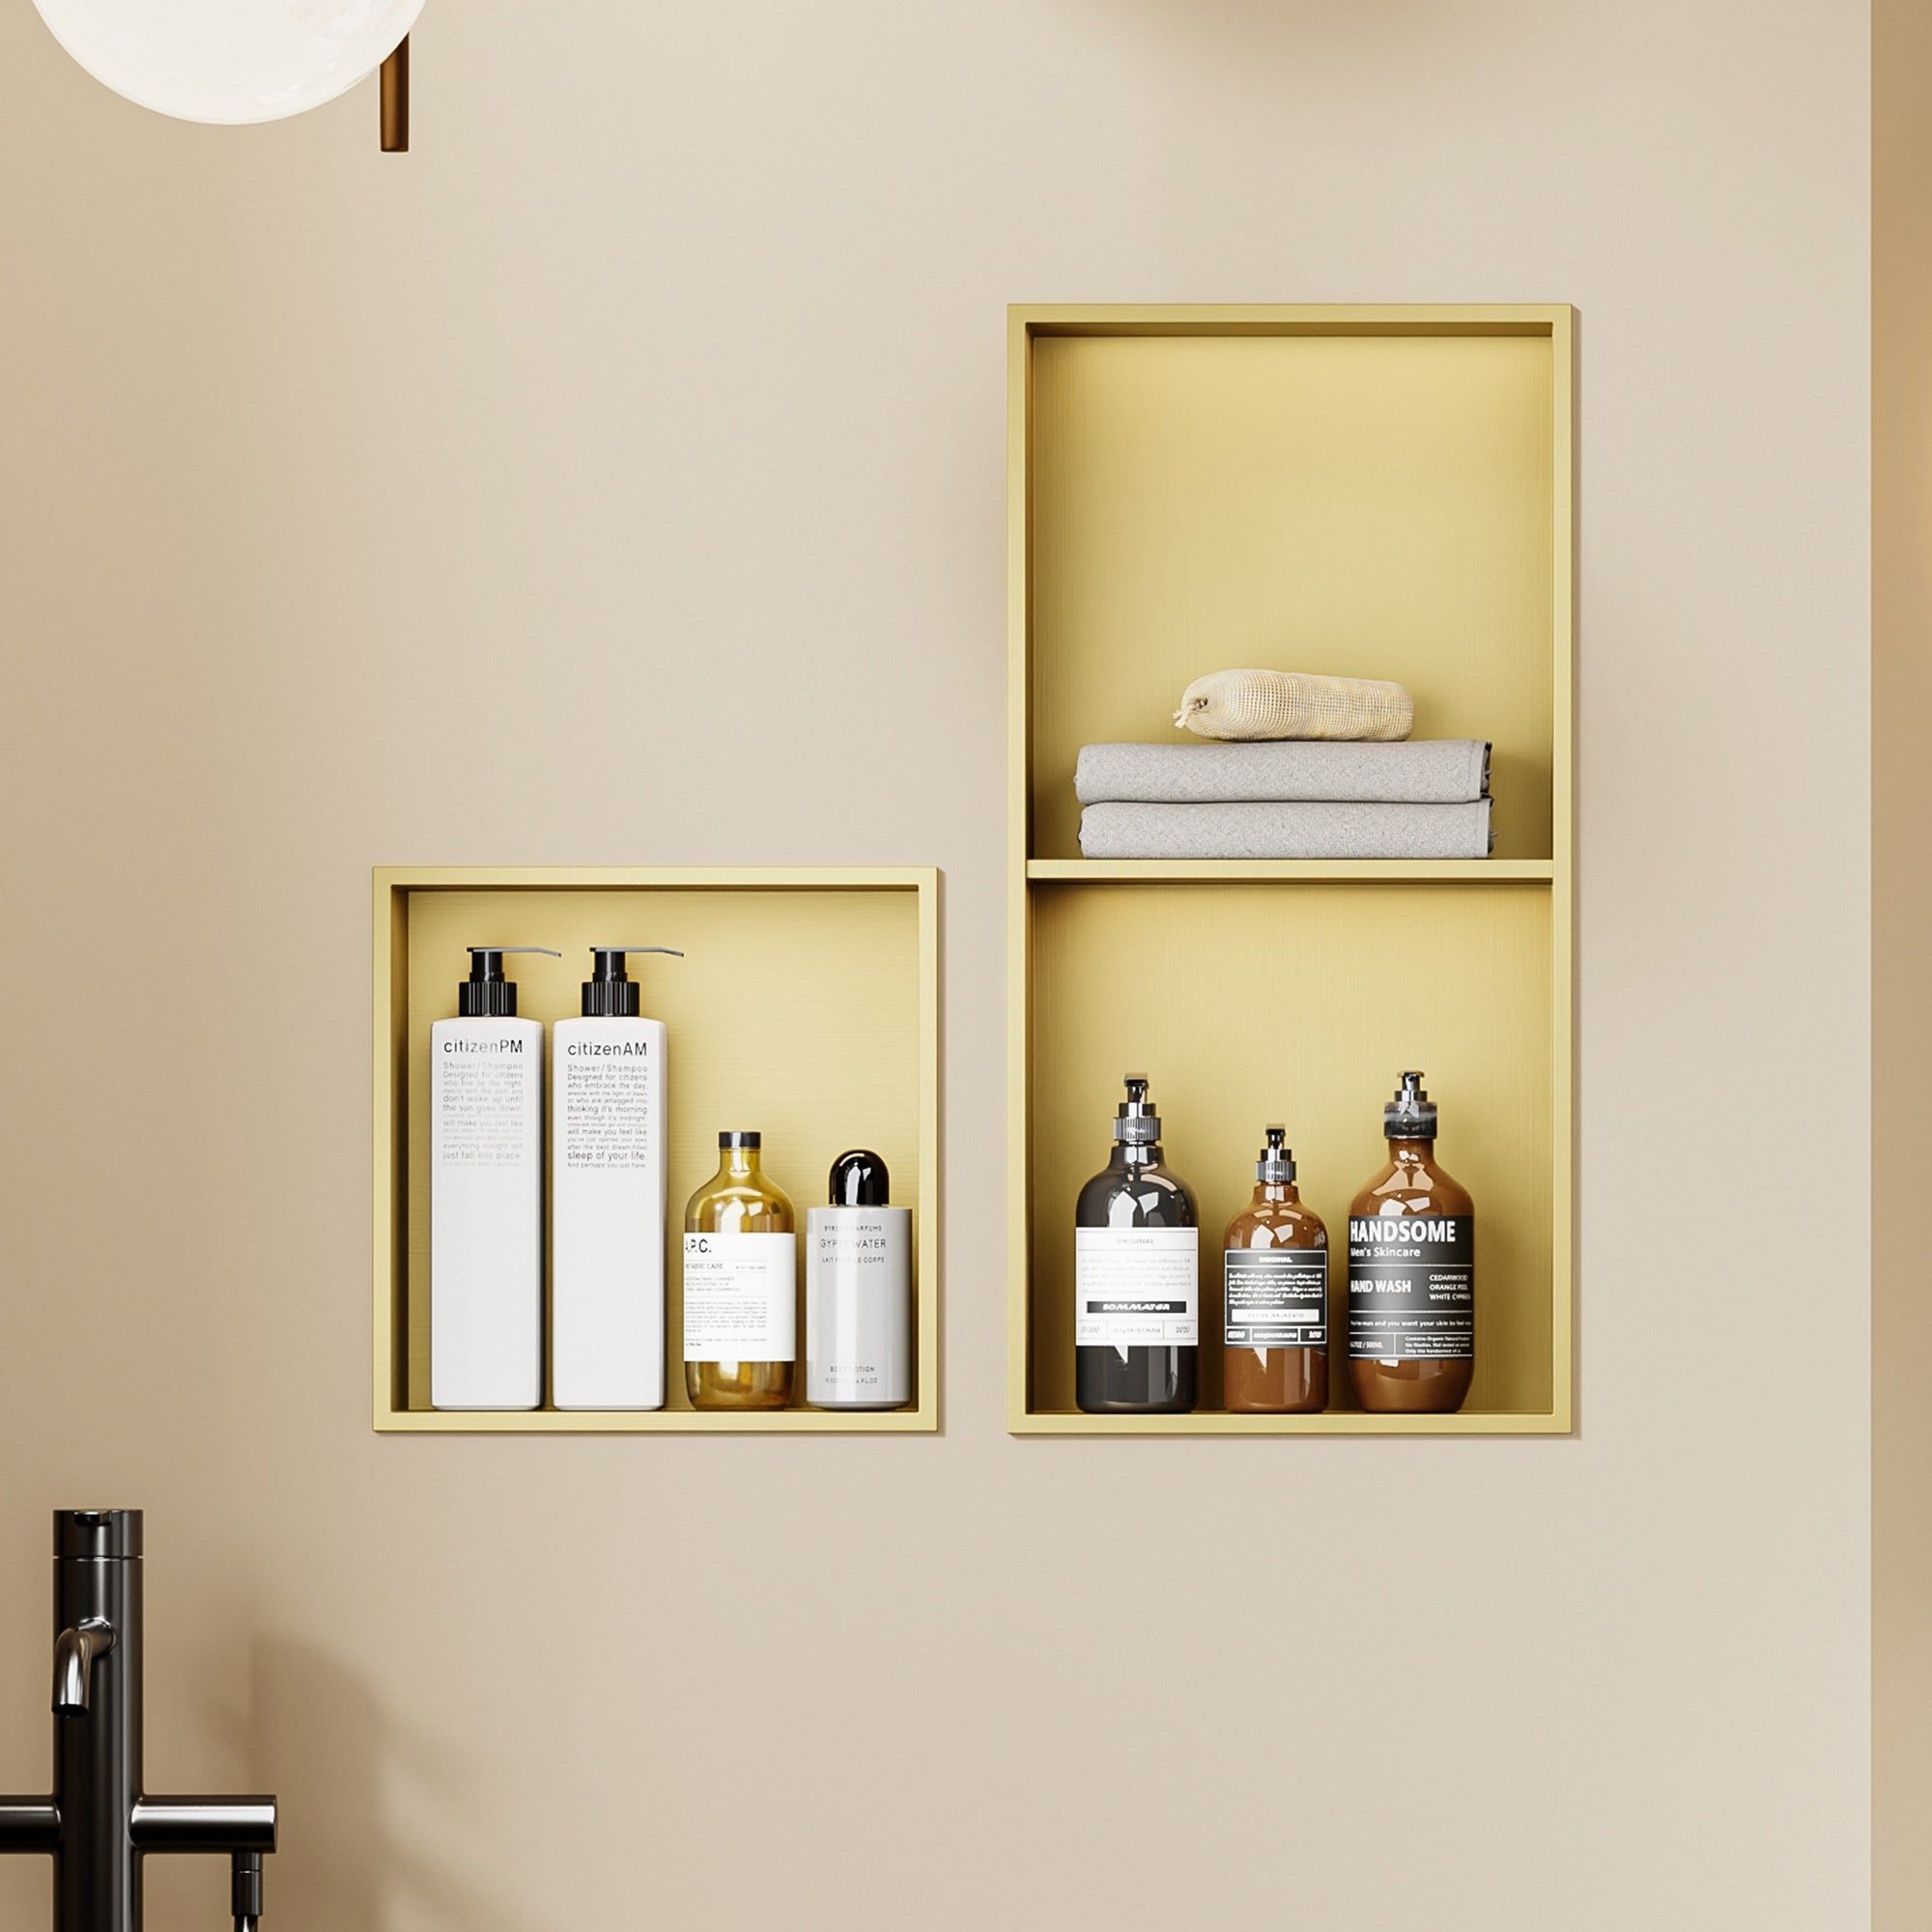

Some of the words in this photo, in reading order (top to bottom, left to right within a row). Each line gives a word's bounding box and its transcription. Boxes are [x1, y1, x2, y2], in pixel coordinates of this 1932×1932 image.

[443, 1039, 523, 1053] citizenPM
[567, 1041, 647, 1056] citizenAM
[443, 1071, 478, 1080] Designed
[567, 1074, 602, 1082] Designed
[567, 1106, 598, 1115] thinking
[616, 1106, 648, 1115] morning
[567, 1151, 594, 1161] sleep
[596, 1151, 605, 1160] of
[608, 1152, 628, 1162] your
[1350, 1220, 1456, 1242] HANDSOME
[820, 1238, 838, 1249] GYP
[1374, 1247, 1421, 1257] Skincare
[1375, 1280, 1412, 1293] WASH
